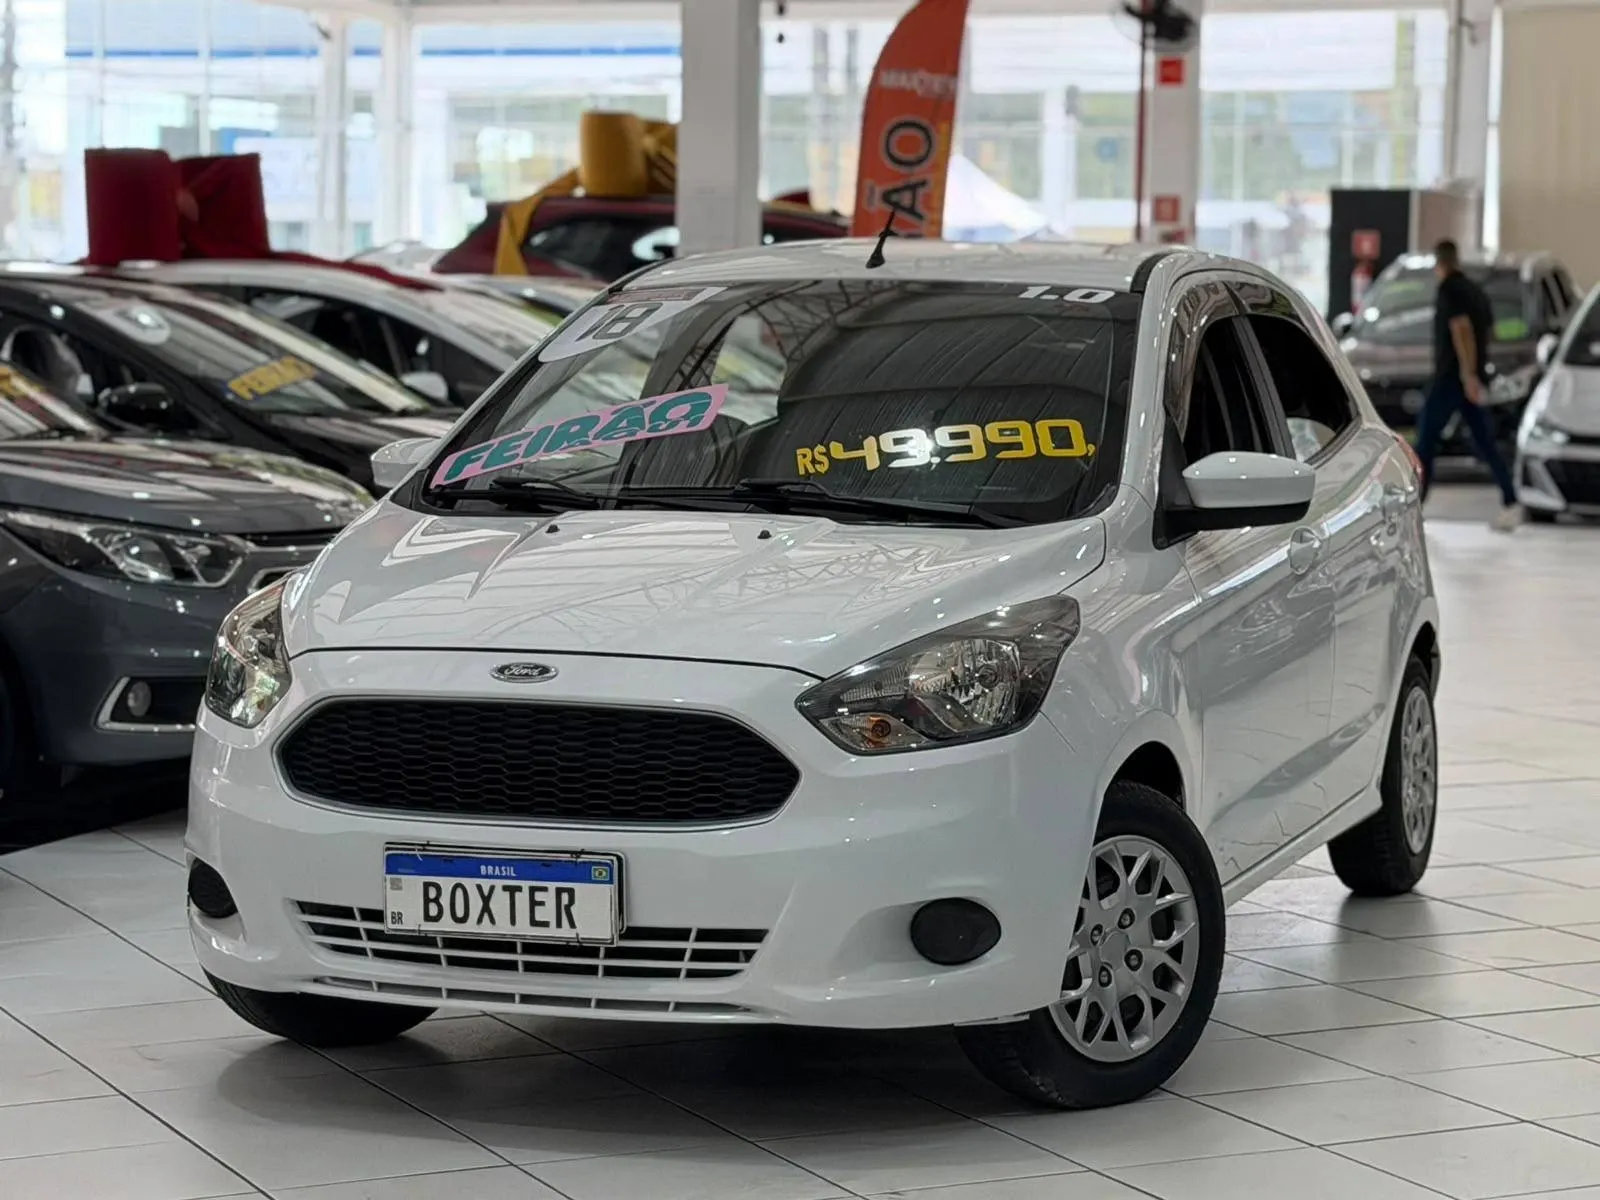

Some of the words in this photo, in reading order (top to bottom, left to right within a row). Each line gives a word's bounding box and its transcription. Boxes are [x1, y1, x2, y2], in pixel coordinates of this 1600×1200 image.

[862, 119, 934, 237] ÃO
[1018, 285, 1116, 303] 1.0
[504, 664, 543, 676] Ford
[480, 864, 516, 878] BRASIL
[422, 881, 577, 930] BOXTER
[390, 911, 404, 925] BR
